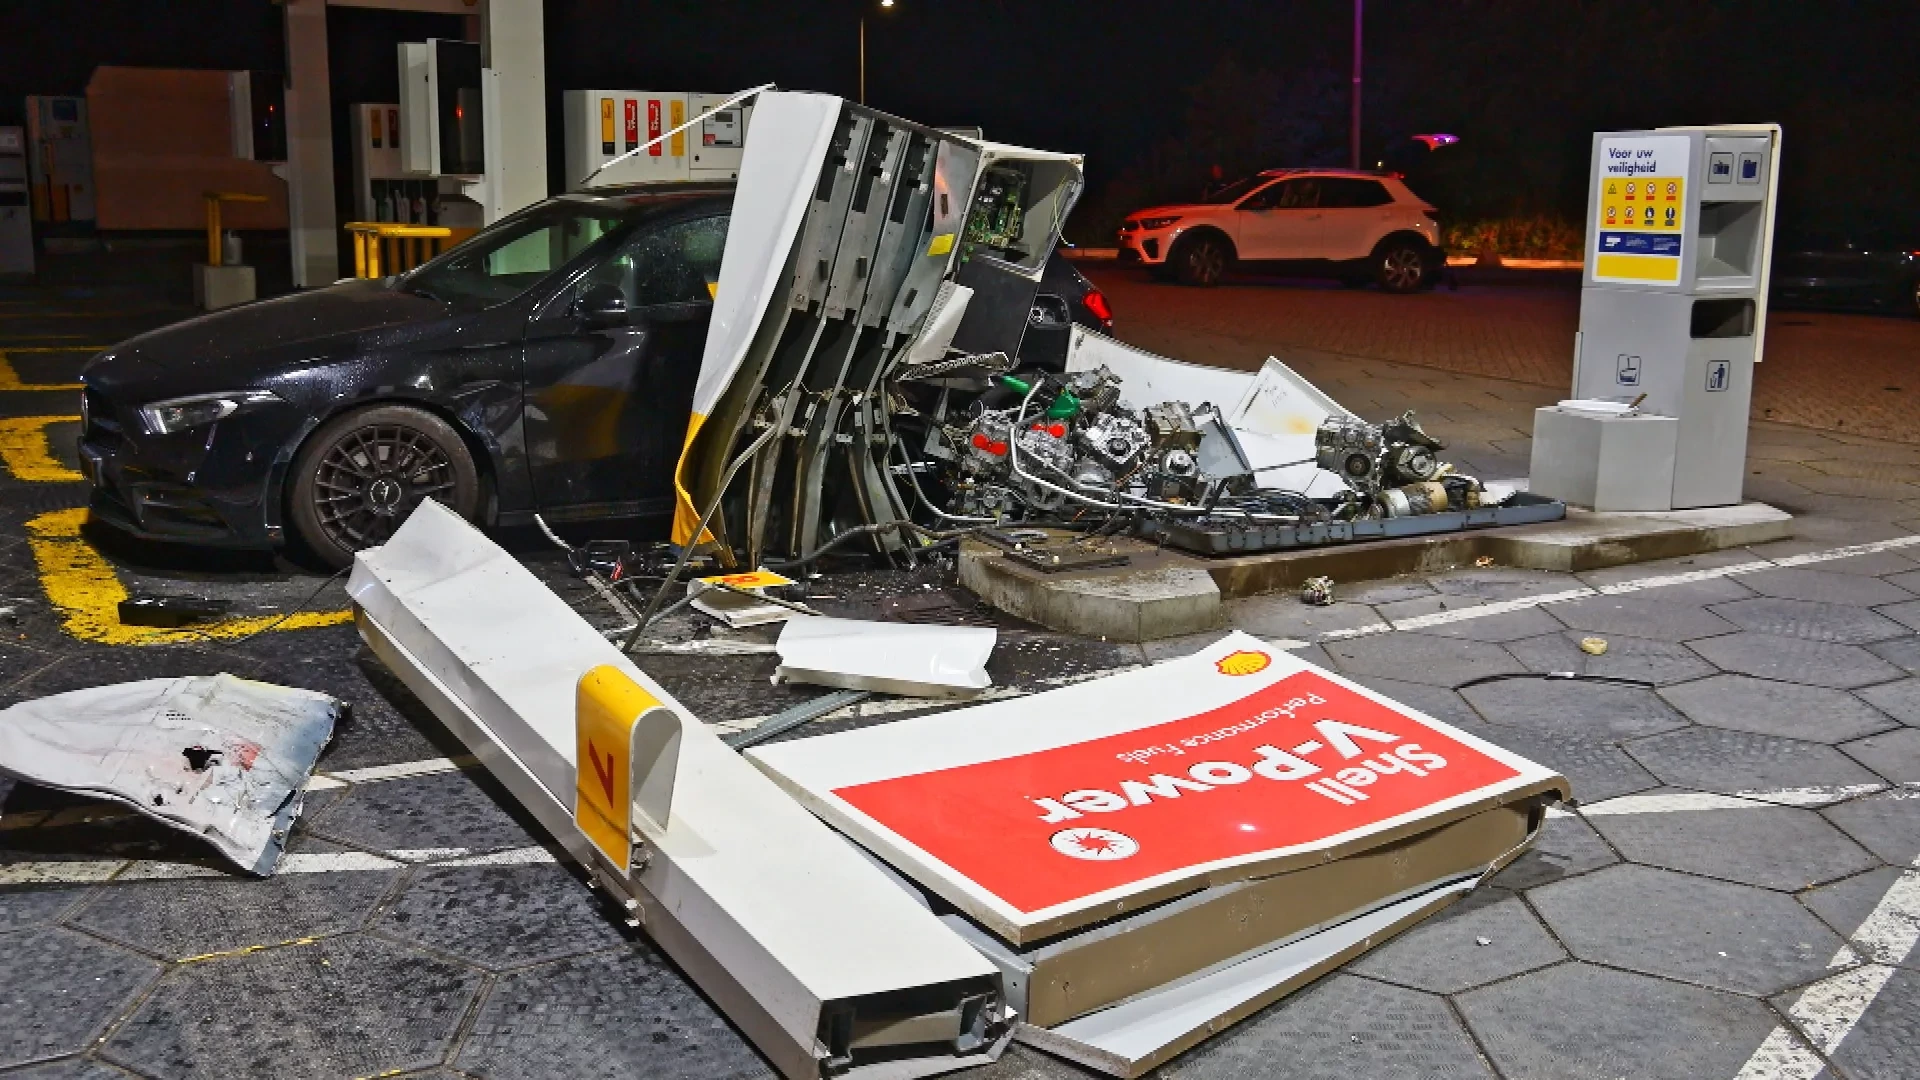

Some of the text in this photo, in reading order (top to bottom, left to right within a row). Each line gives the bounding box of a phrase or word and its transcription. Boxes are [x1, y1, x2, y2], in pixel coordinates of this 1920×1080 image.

[1607, 161, 1657, 176] veiligheid
[1609, 147, 1654, 159] Voor uw
[1116, 692, 1327, 765] Performance Fuels
[1033, 718, 1402, 824] V-Power
[1304, 743, 1448, 806] Shell
